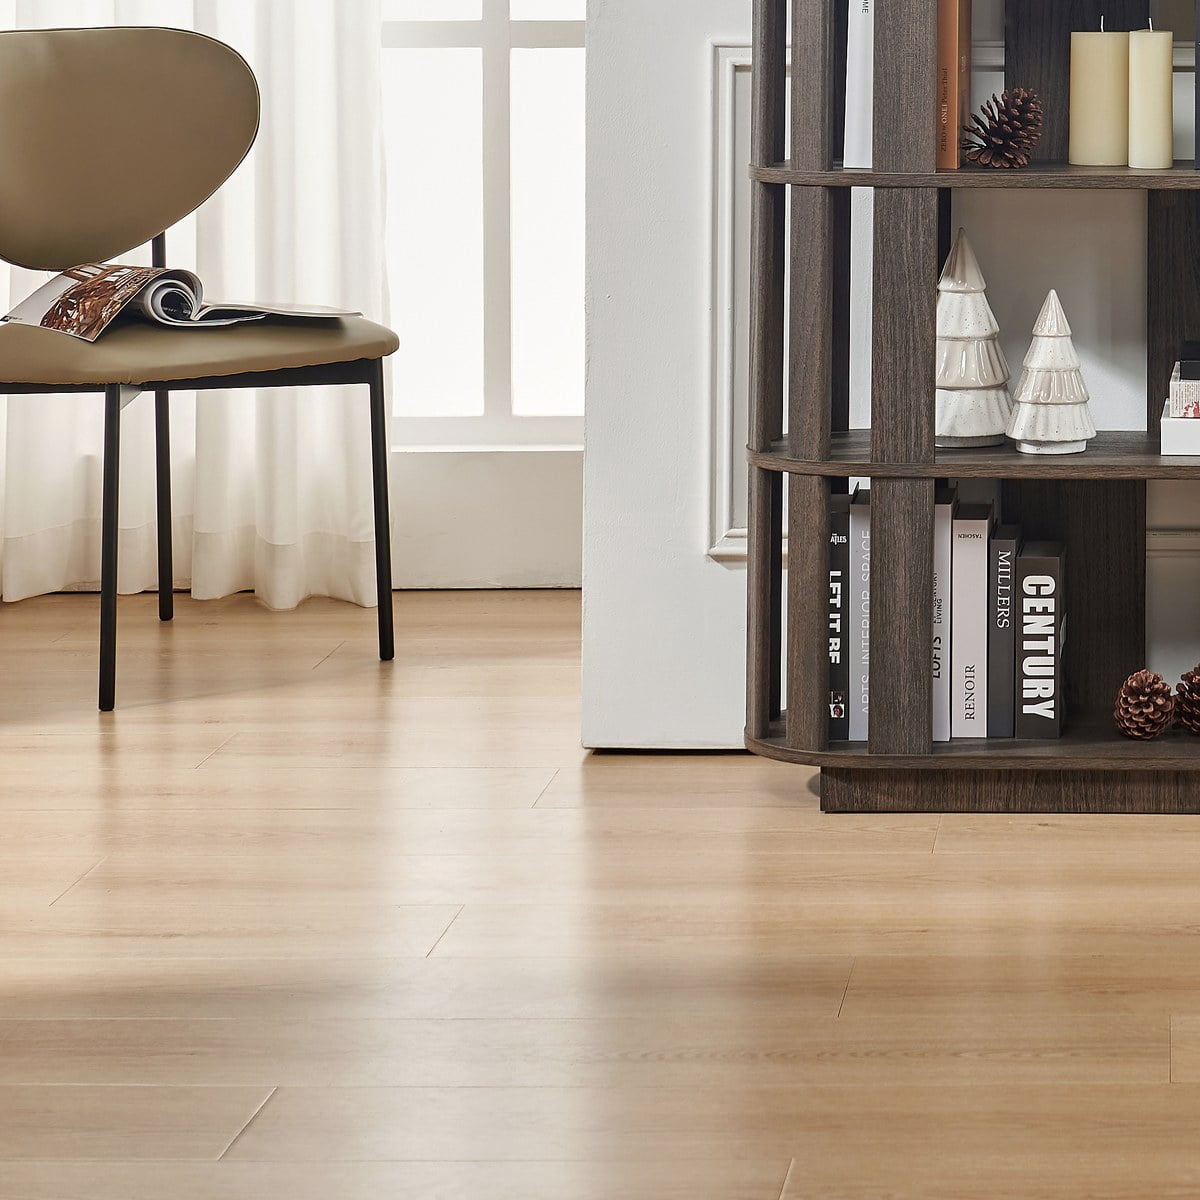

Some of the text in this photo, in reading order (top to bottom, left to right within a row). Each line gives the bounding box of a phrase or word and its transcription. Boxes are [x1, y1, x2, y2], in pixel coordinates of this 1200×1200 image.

[830, 535, 847, 545] ATLES
[997, 550, 1011, 629] MILLERS
[1021, 575, 1056, 720] CENTURY
[964, 664, 975, 721] RENOIR
